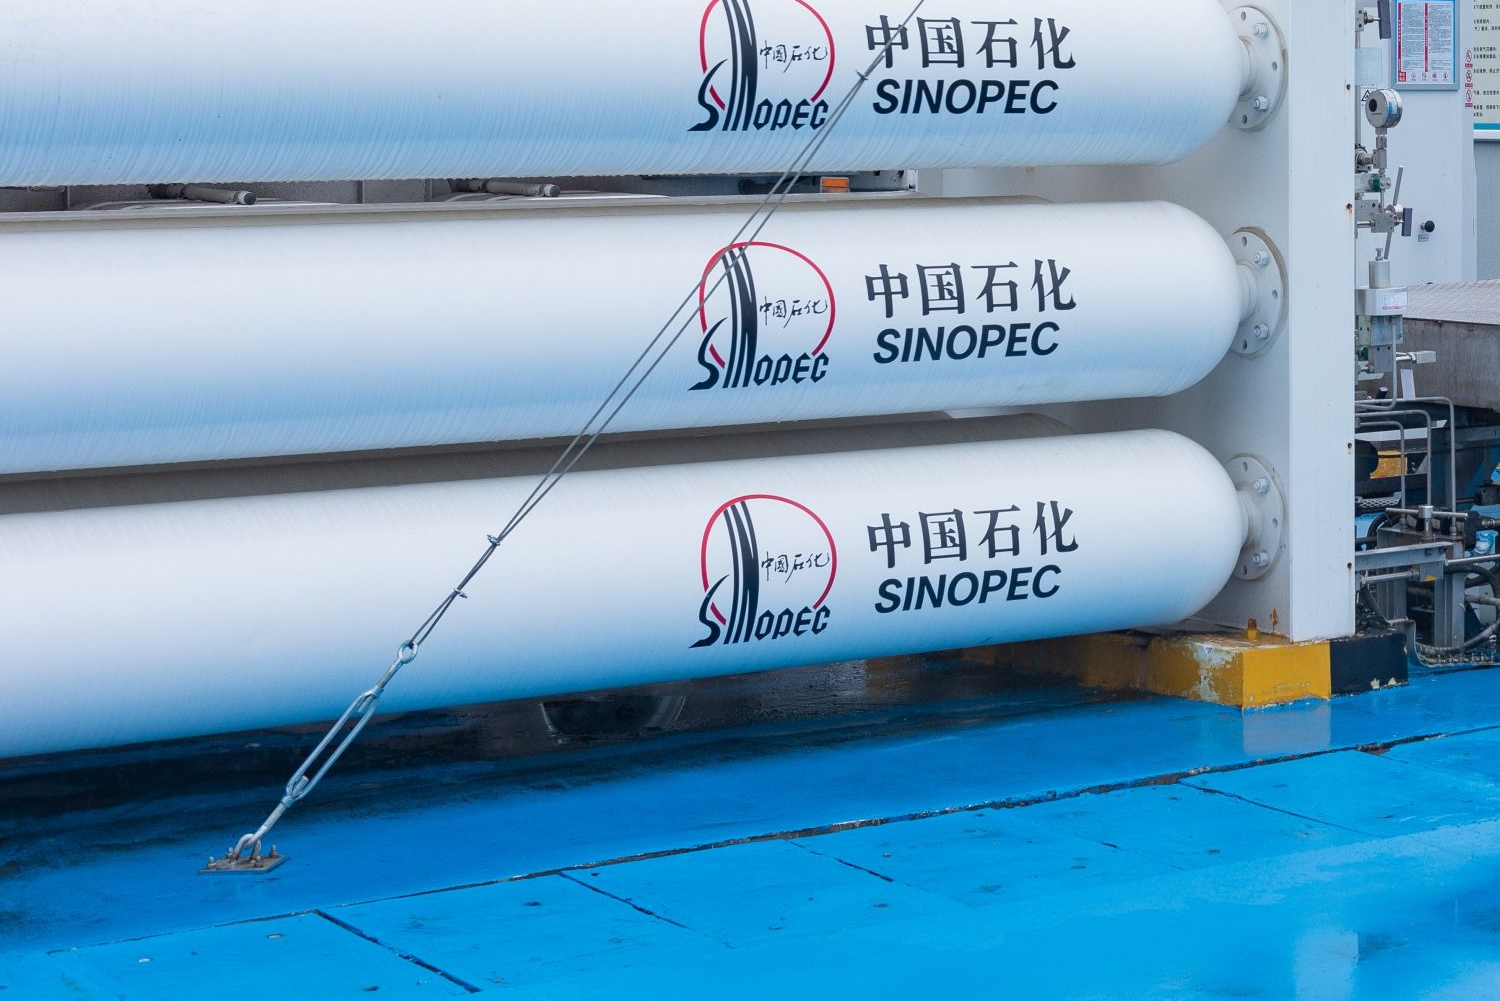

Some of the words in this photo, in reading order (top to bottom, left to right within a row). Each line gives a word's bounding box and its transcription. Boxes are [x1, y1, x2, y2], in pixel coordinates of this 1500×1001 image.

[865, 15, 1076, 70] 中国石化
[872, 78, 1059, 115] SINOPEC
[865, 259, 1077, 318] 中国石化
[873, 321, 1060, 364] SINOPEC
[867, 500, 1079, 569] 中国石化
[874, 564, 1062, 614] SINOPEC
